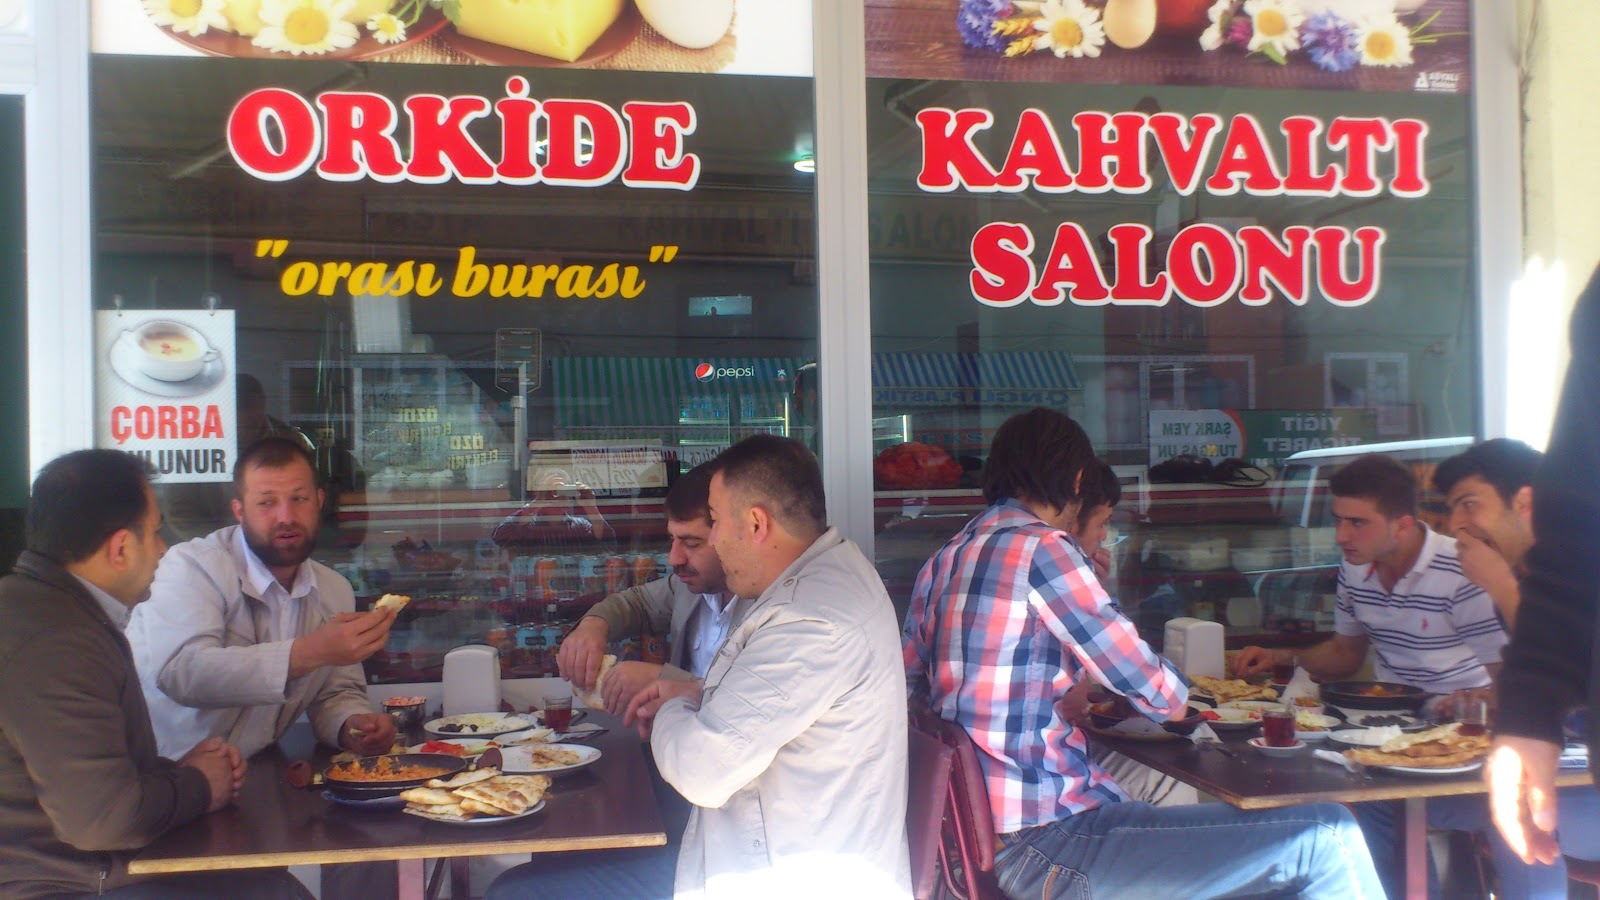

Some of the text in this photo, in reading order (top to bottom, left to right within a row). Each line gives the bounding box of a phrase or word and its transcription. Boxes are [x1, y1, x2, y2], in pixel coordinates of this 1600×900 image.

[228, 77, 700, 190] ORKİDE
[917, 109, 1430, 198] KAHVALTI
[256, 240, 678, 299] "orası burası"
[970, 222, 1386, 307] SALONU
[716, 365, 755, 379] pepsi
[112, 405, 223, 444] ÇORBA
[128, 448, 226, 475] LUNUR
